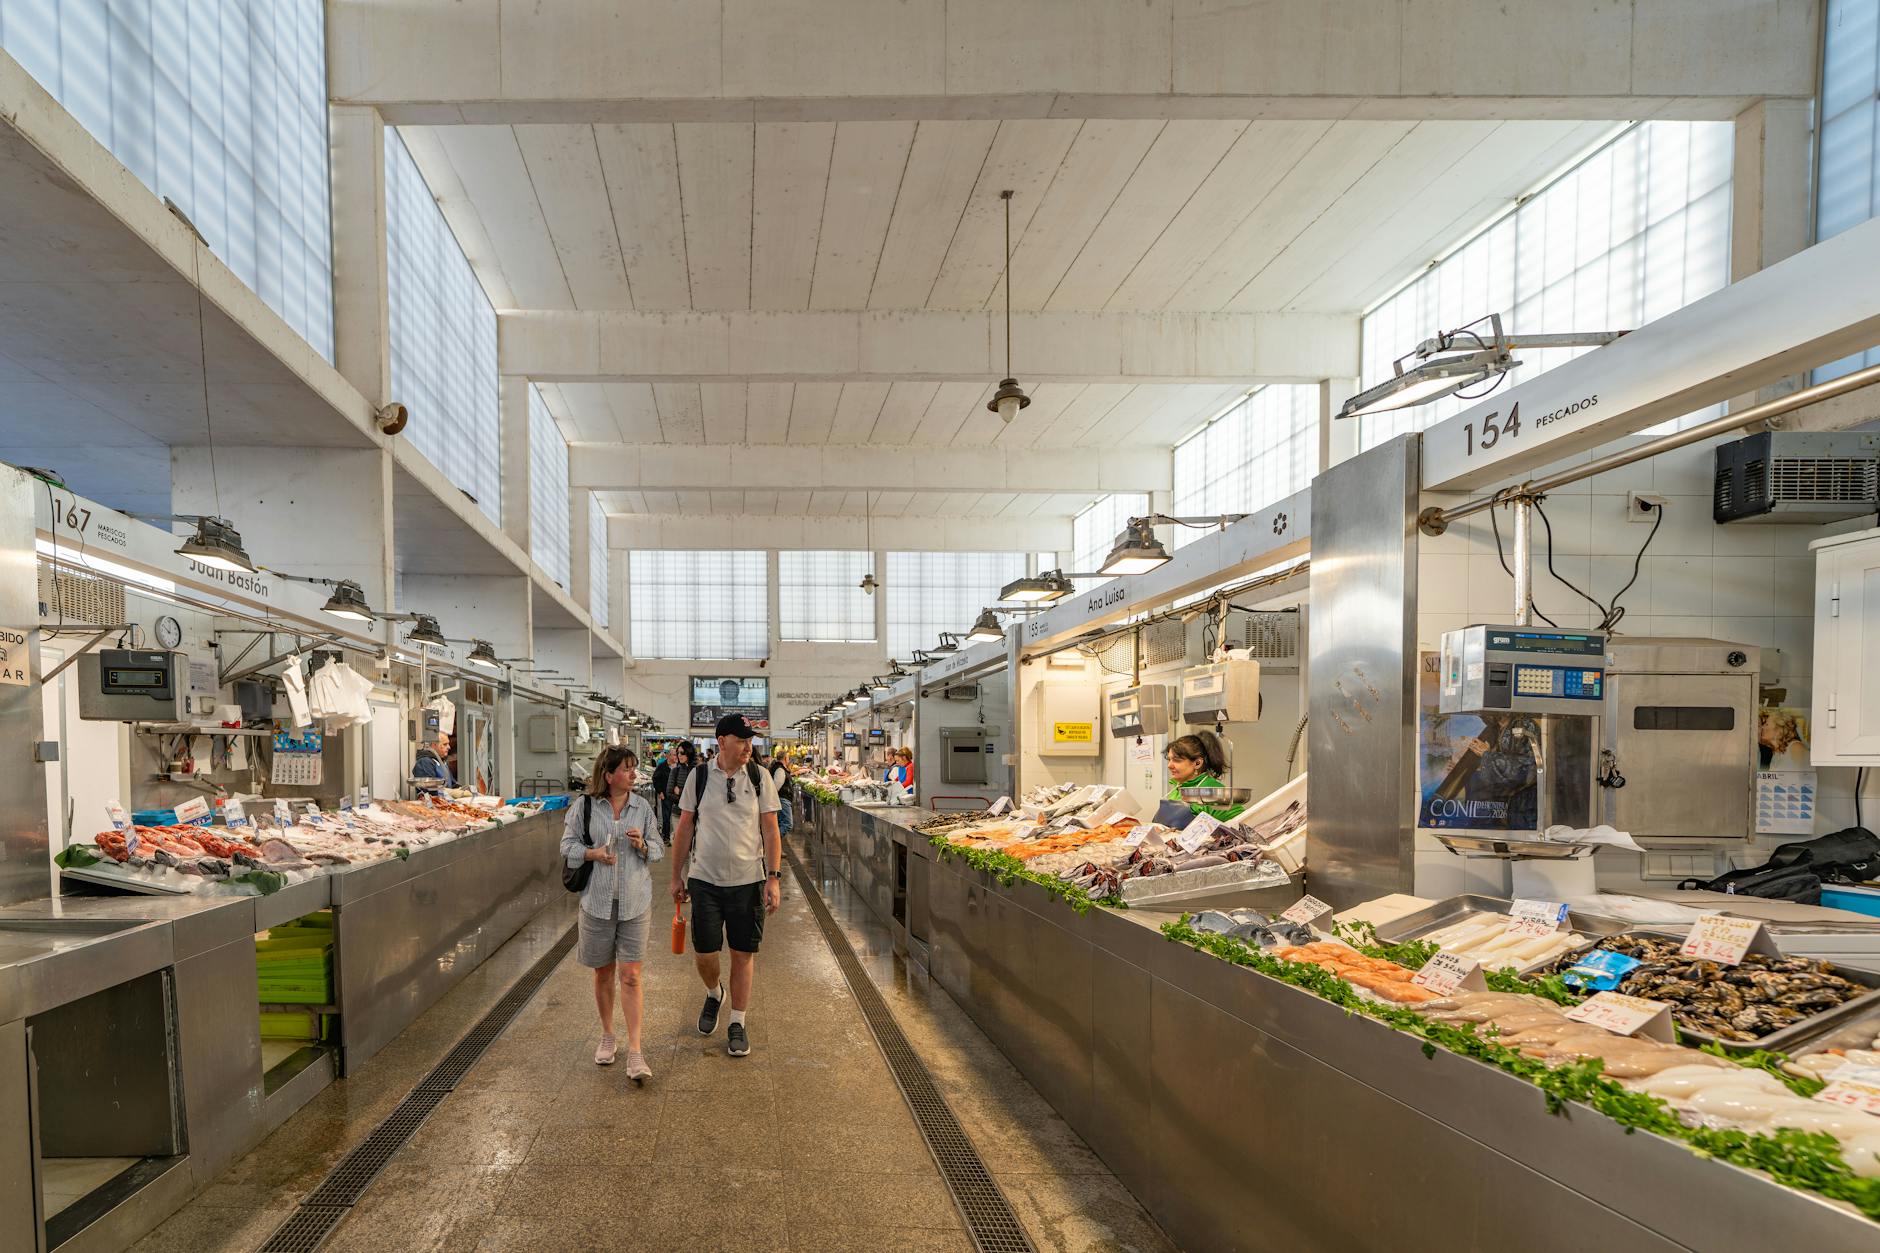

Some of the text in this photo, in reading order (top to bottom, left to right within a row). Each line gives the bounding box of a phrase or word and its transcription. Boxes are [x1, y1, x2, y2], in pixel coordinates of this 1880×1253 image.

[1463, 394, 1599, 457] 154 PESCADOS
[54, 498, 92, 532] 167
[97, 523, 127, 539] MARISCOS
[97, 531, 127, 547] PESCADOS
[189, 559, 269, 598] Juan Bastón
[1087, 586, 1125, 614] Ana Luisa
[1430, 799, 1491, 818] CONIL
